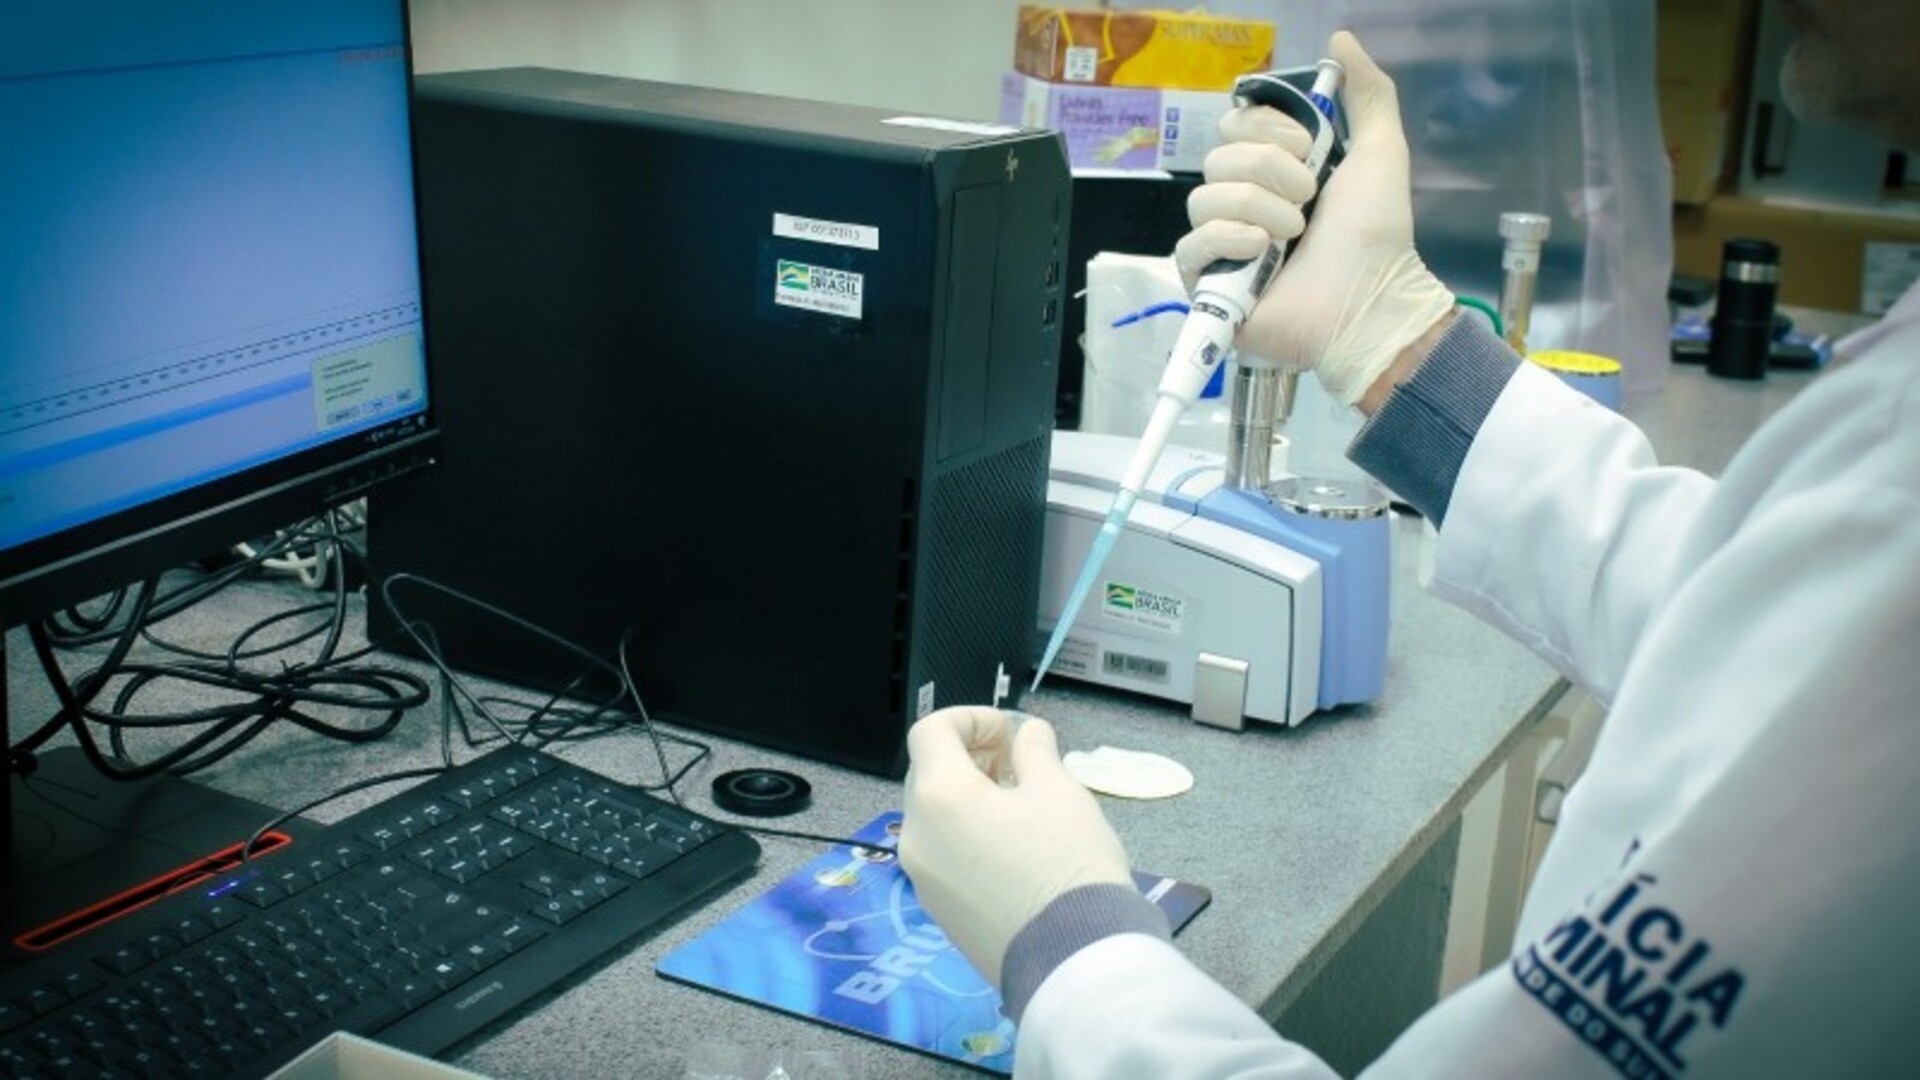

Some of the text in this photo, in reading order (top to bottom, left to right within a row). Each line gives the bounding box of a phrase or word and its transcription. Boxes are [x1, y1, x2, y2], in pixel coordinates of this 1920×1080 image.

[811, 275, 859, 296] BRASIL
[832, 923, 957, 1005] BRU
[1590, 840, 1747, 1030] ÍCIA
[1566, 1000, 1608, 1042] DO
